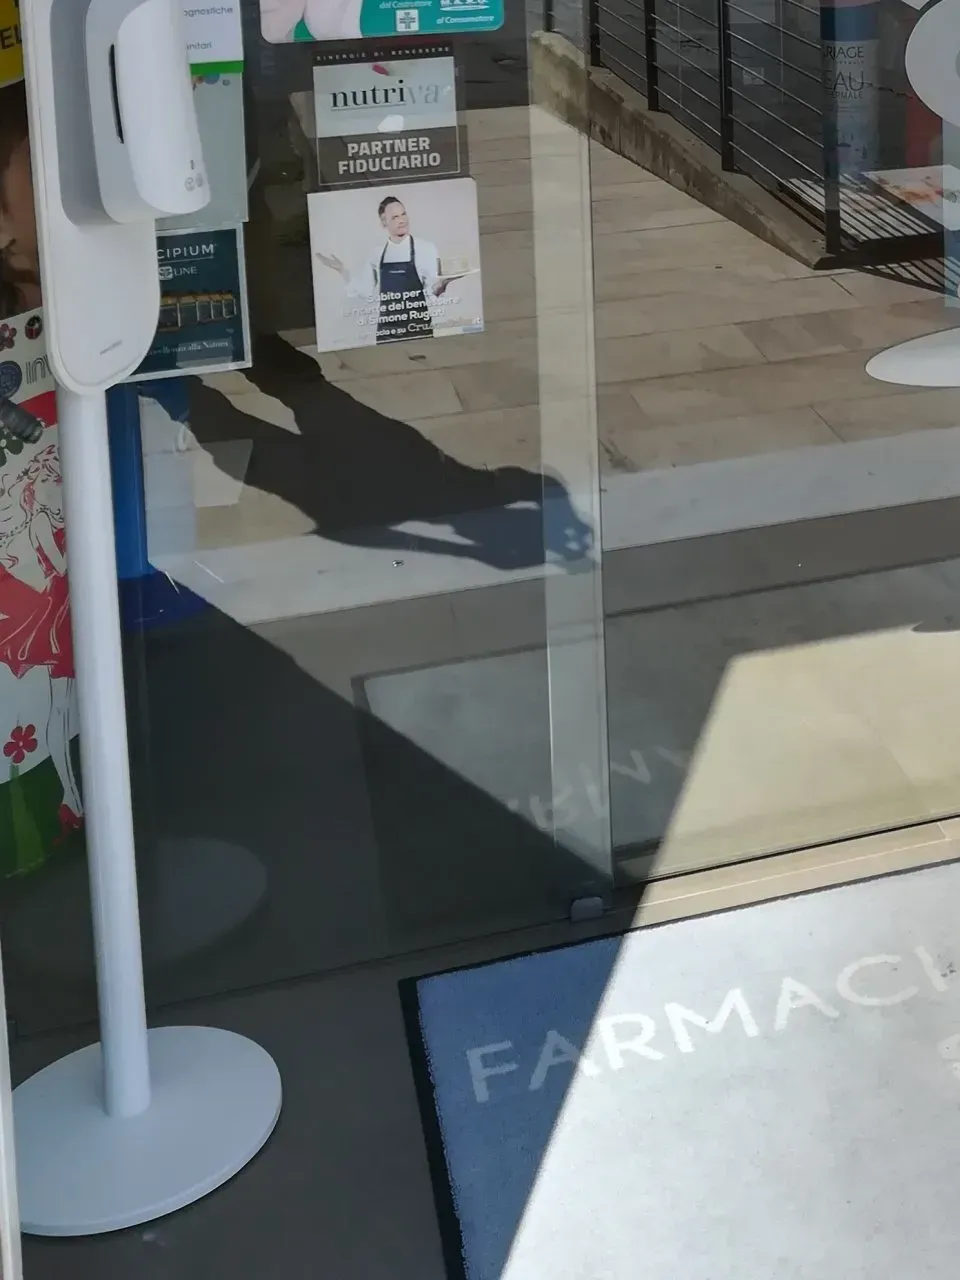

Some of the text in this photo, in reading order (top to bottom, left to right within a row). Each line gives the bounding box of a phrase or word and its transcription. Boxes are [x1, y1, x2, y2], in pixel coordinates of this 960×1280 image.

[183, 6, 234, 17] agnostiche
[185, 40, 213, 51] nitari
[825, 46, 865, 60] RIAGE
[347, 136, 431, 157] PARTNER
[338, 152, 441, 175] FIDUCIARIO
[157, 243, 215, 259] CIPIUM
[368, 291, 402, 304] Sbito
[402, 289, 422, 301] per
[388, 300, 405, 312] del
